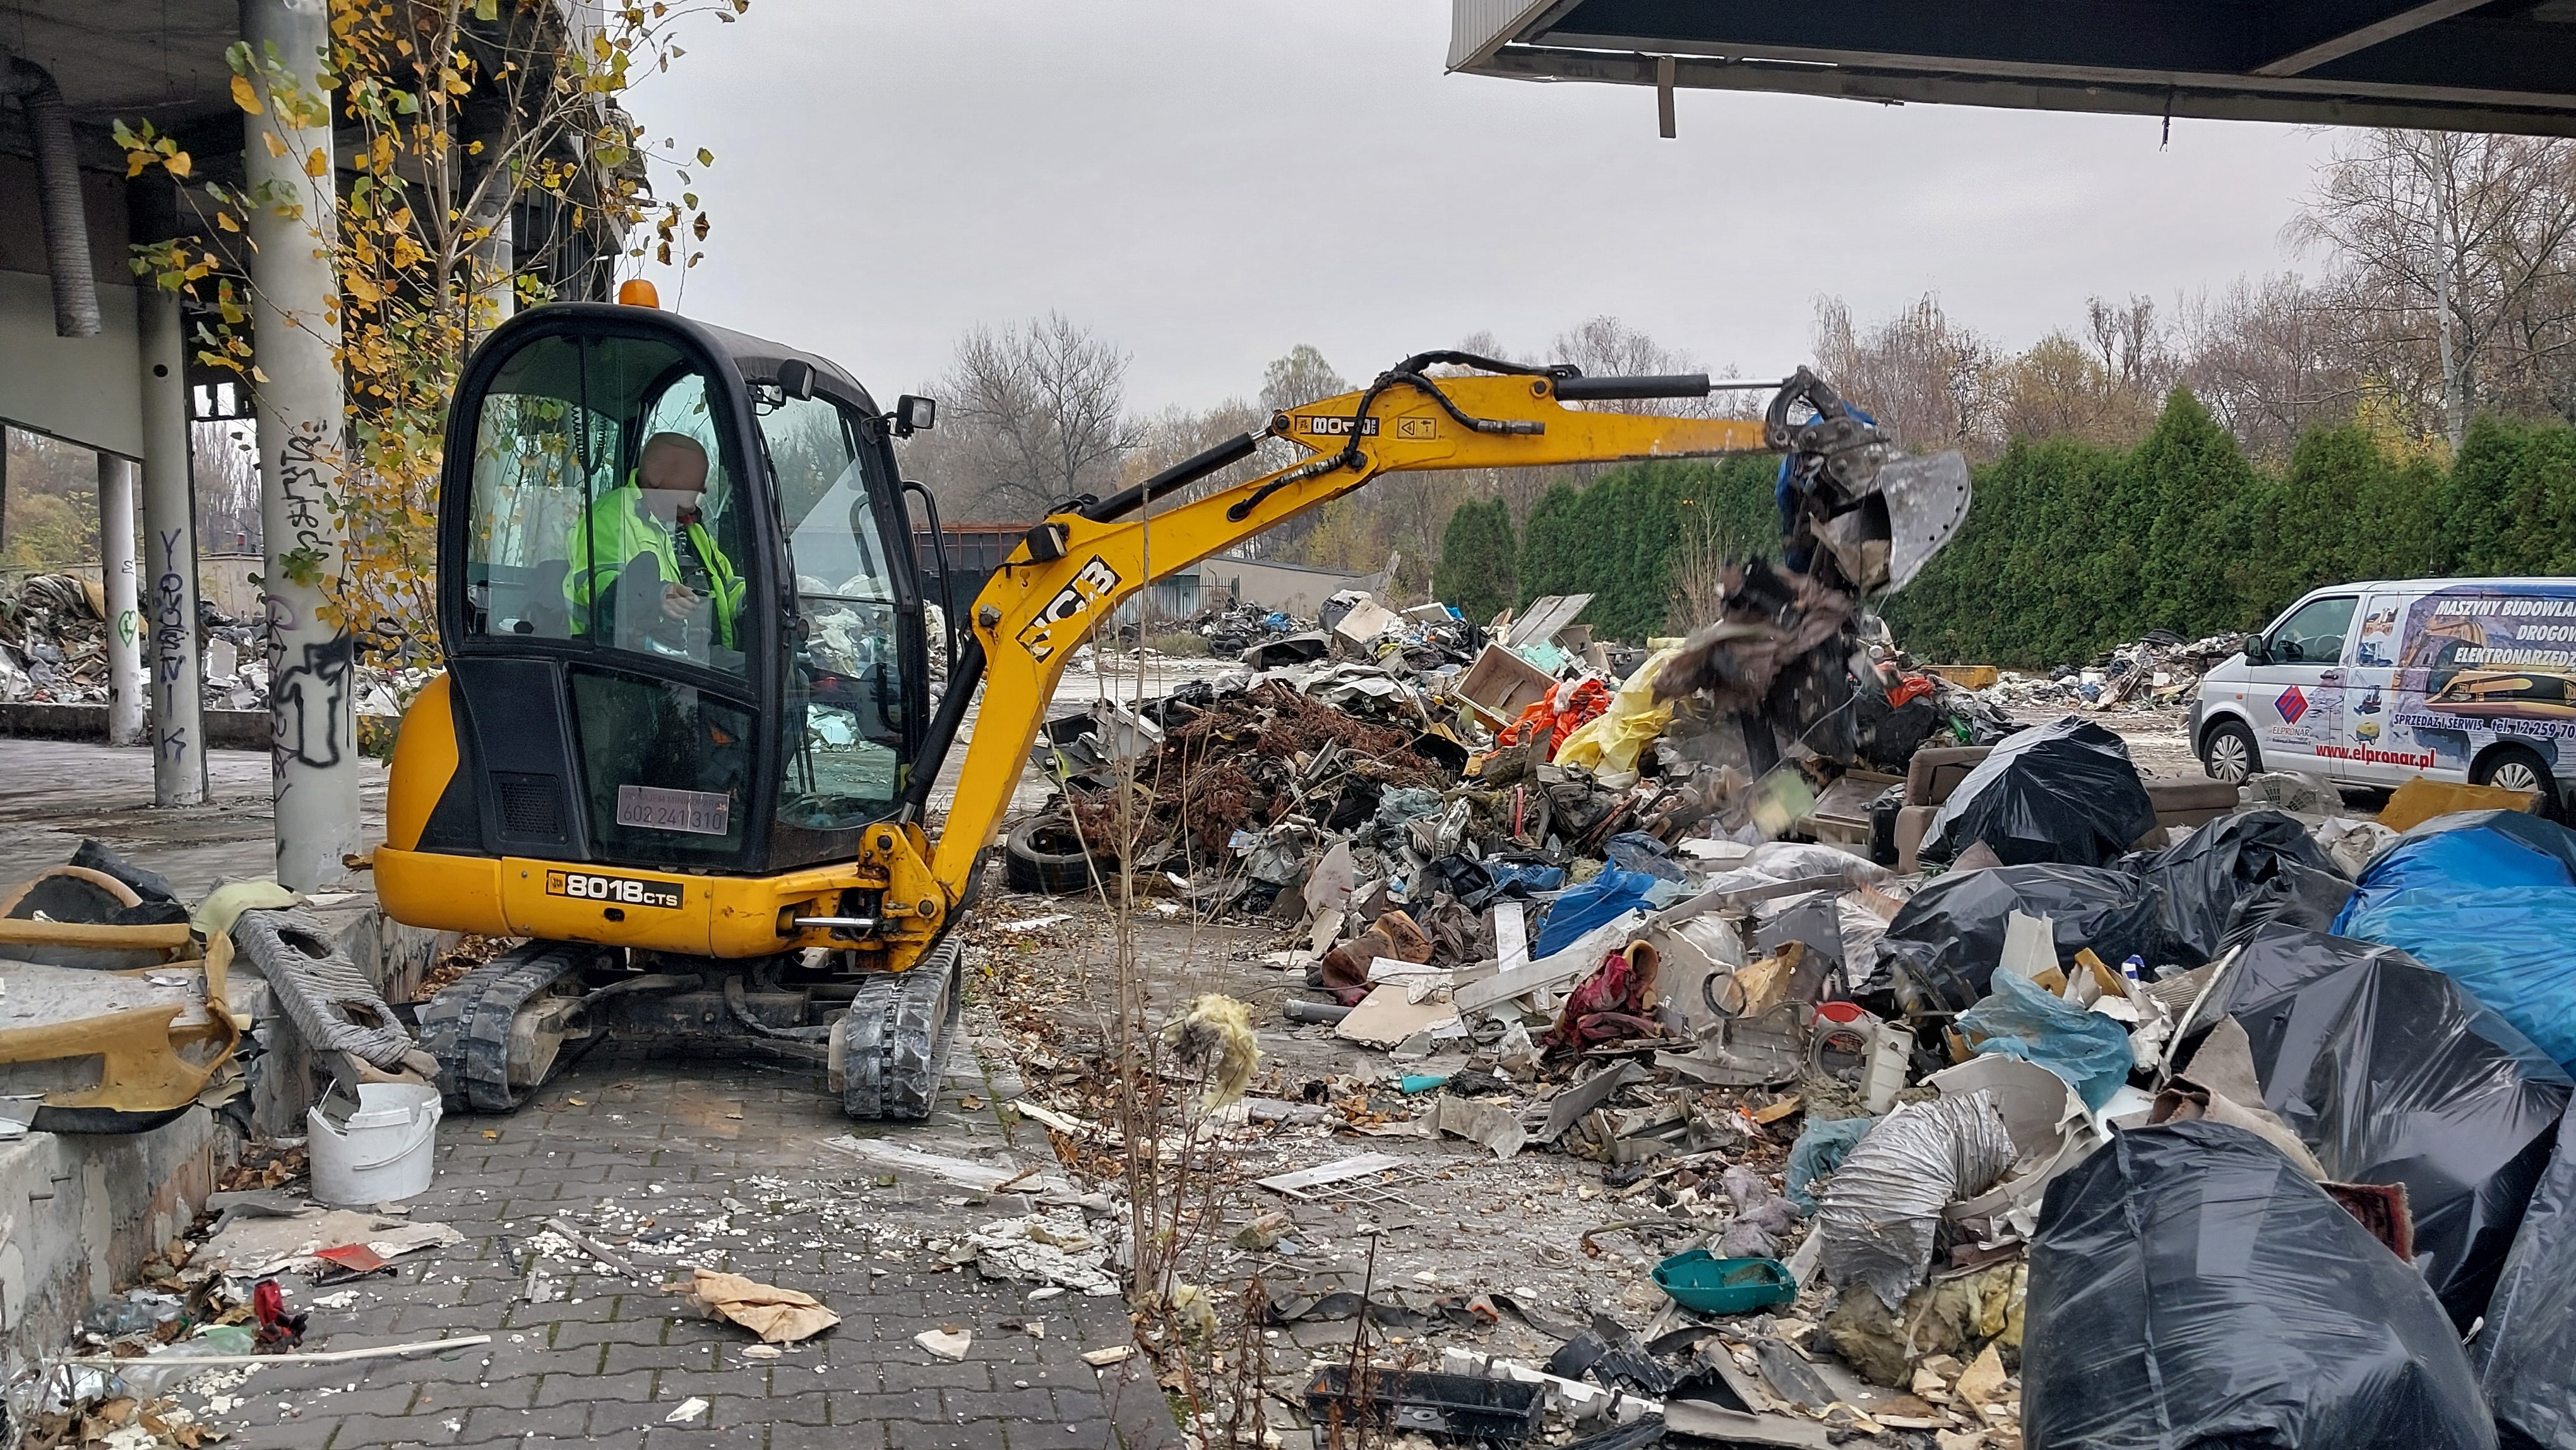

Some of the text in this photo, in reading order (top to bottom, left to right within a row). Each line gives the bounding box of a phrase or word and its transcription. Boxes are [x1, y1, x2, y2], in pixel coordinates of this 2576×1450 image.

[2435, 601, 2502, 616] MASZYNY
[2273, 726, 2310, 737] ELPRONAR
[2394, 713, 2440, 728] SPRZEDAŻ
[2448, 717, 2484, 731] SERWIS
[2491, 719, 2510, 733] tel.
[2533, 722, 2556, 737] 259
[2315, 743, 2435, 770] www.elpronar.pl
[624, 804, 722, 830] 602 241 310
